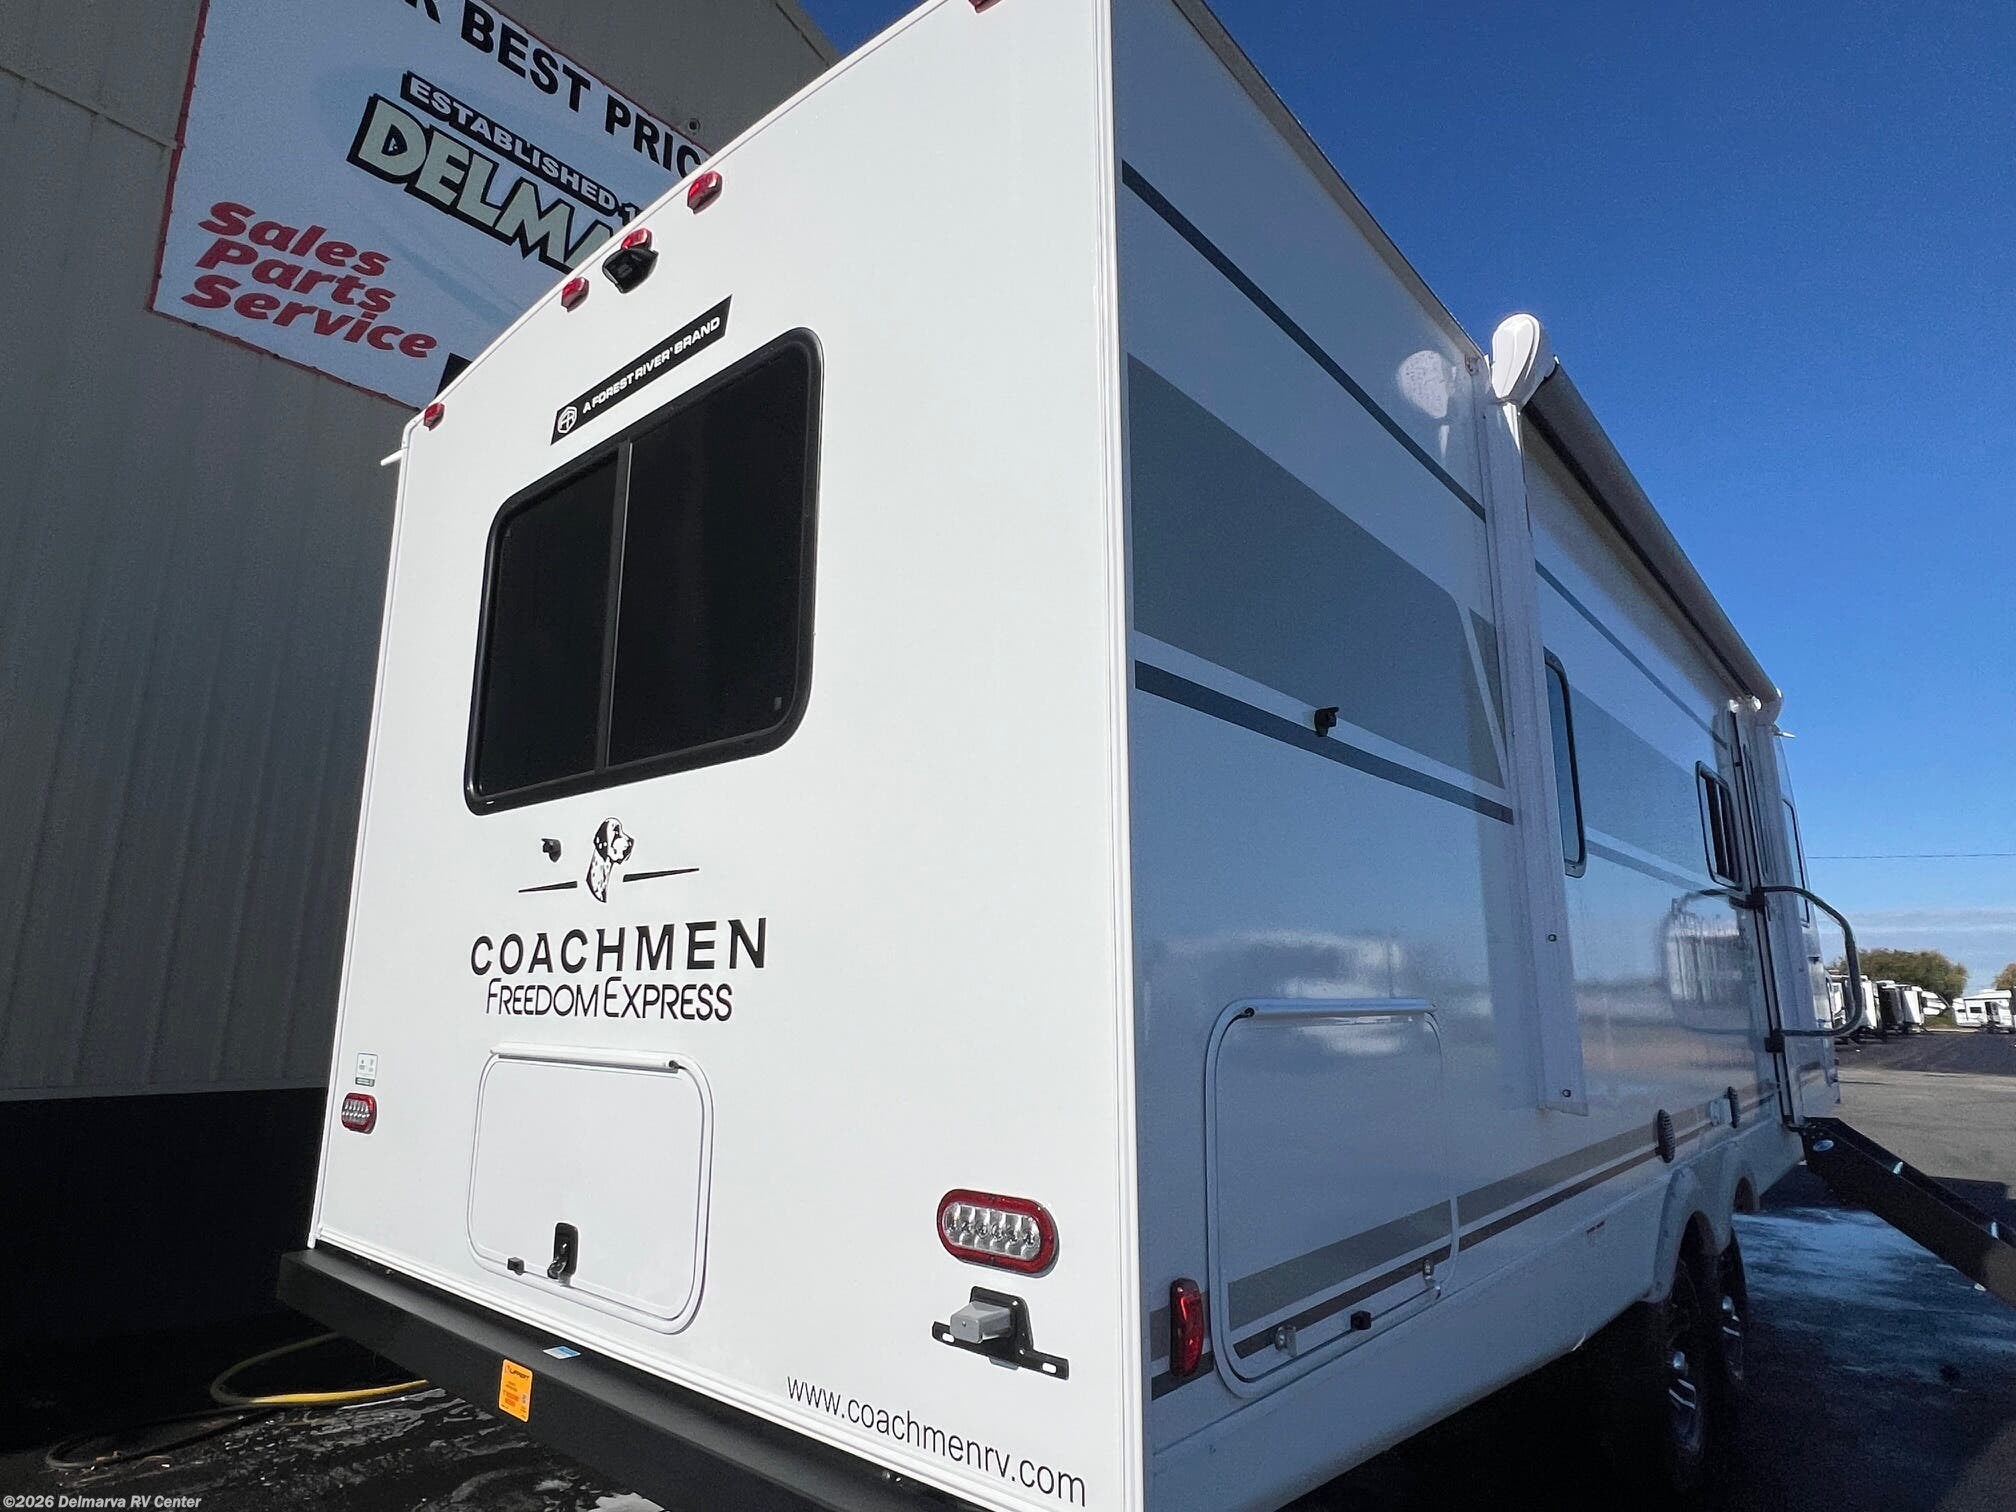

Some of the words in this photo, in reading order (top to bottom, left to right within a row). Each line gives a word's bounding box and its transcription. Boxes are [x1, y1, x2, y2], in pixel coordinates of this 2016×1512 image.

[461, 0, 590, 113] BEST
[407, 74, 617, 213] ESTABLISHED
[195, 238, 396, 312] Parts
[198, 202, 392, 276] Sales
[181, 274, 437, 358] Service
[583, 401, 592, 413] A
[592, 373, 635, 408] FOREST
[674, 316, 721, 355] BRAND
[470, 917, 766, 975] COACHMEN
[787, 1376, 1086, 1506] www.coachmenrv.com
